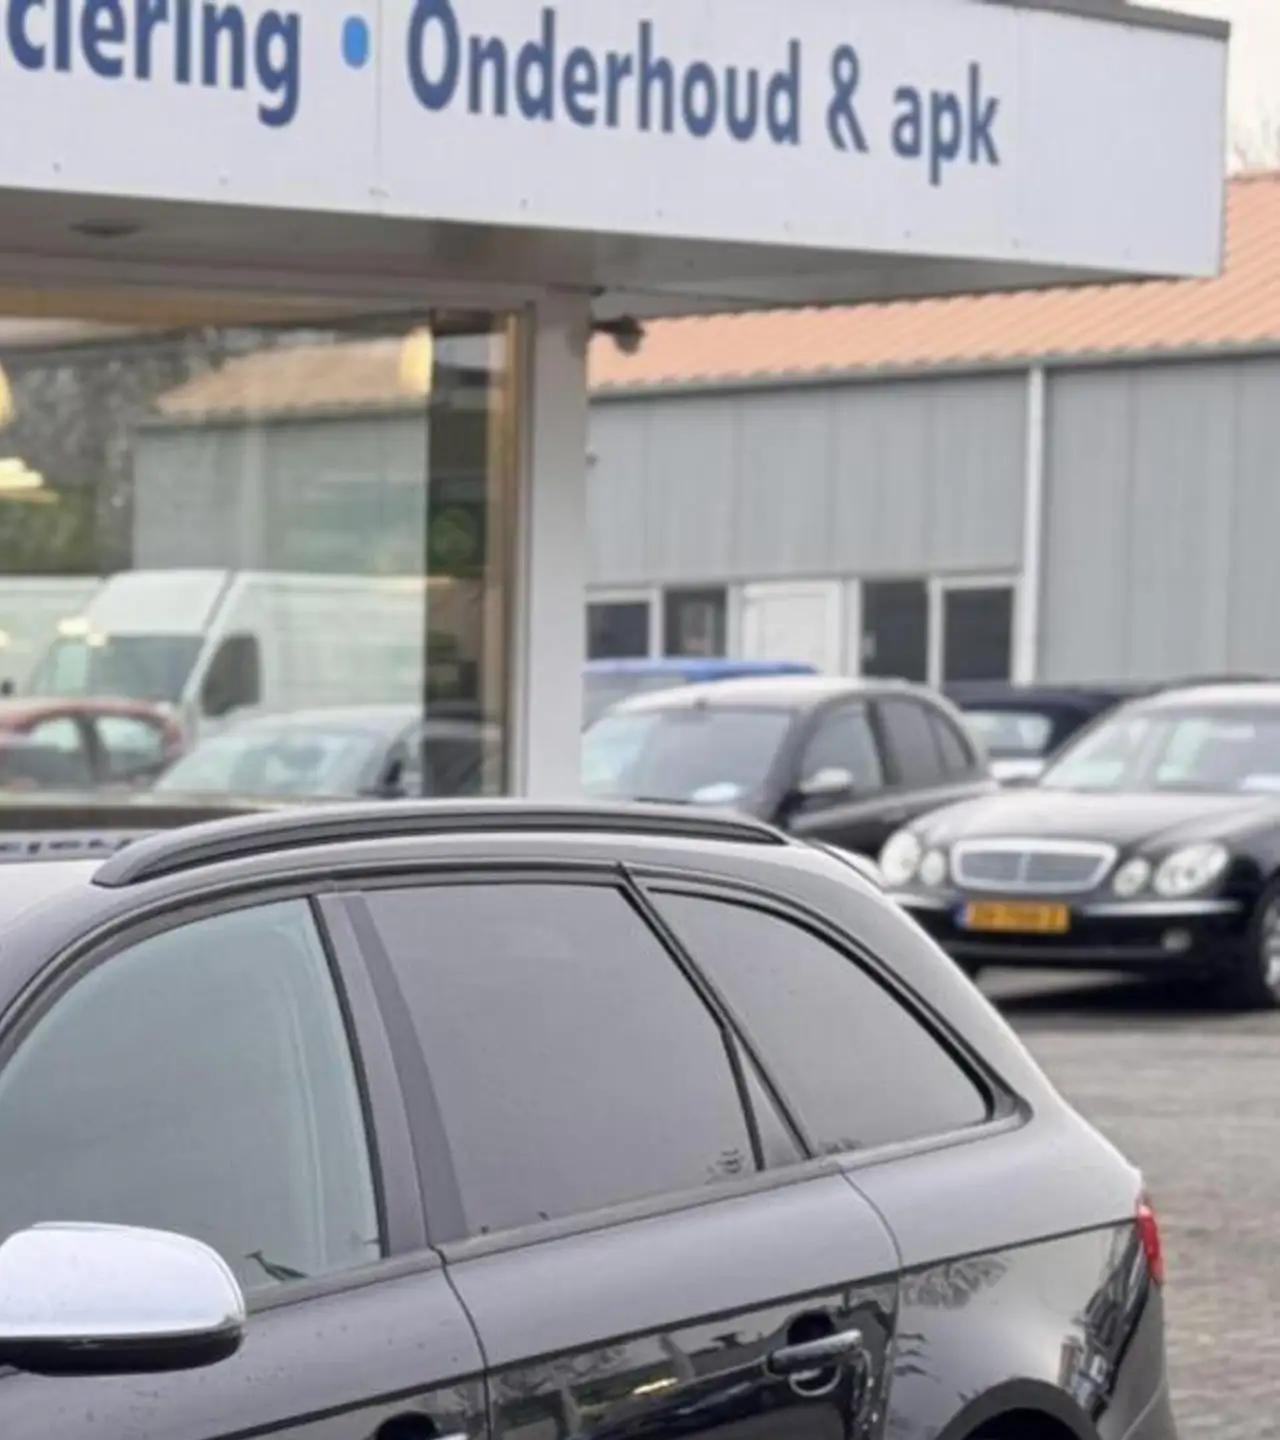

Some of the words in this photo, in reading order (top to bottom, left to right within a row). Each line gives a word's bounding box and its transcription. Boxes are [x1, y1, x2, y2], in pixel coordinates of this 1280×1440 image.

[406, 0, 801, 145] Onderhoud
[826, 43, 870, 153] &
[891, 61, 1001, 187] apk
